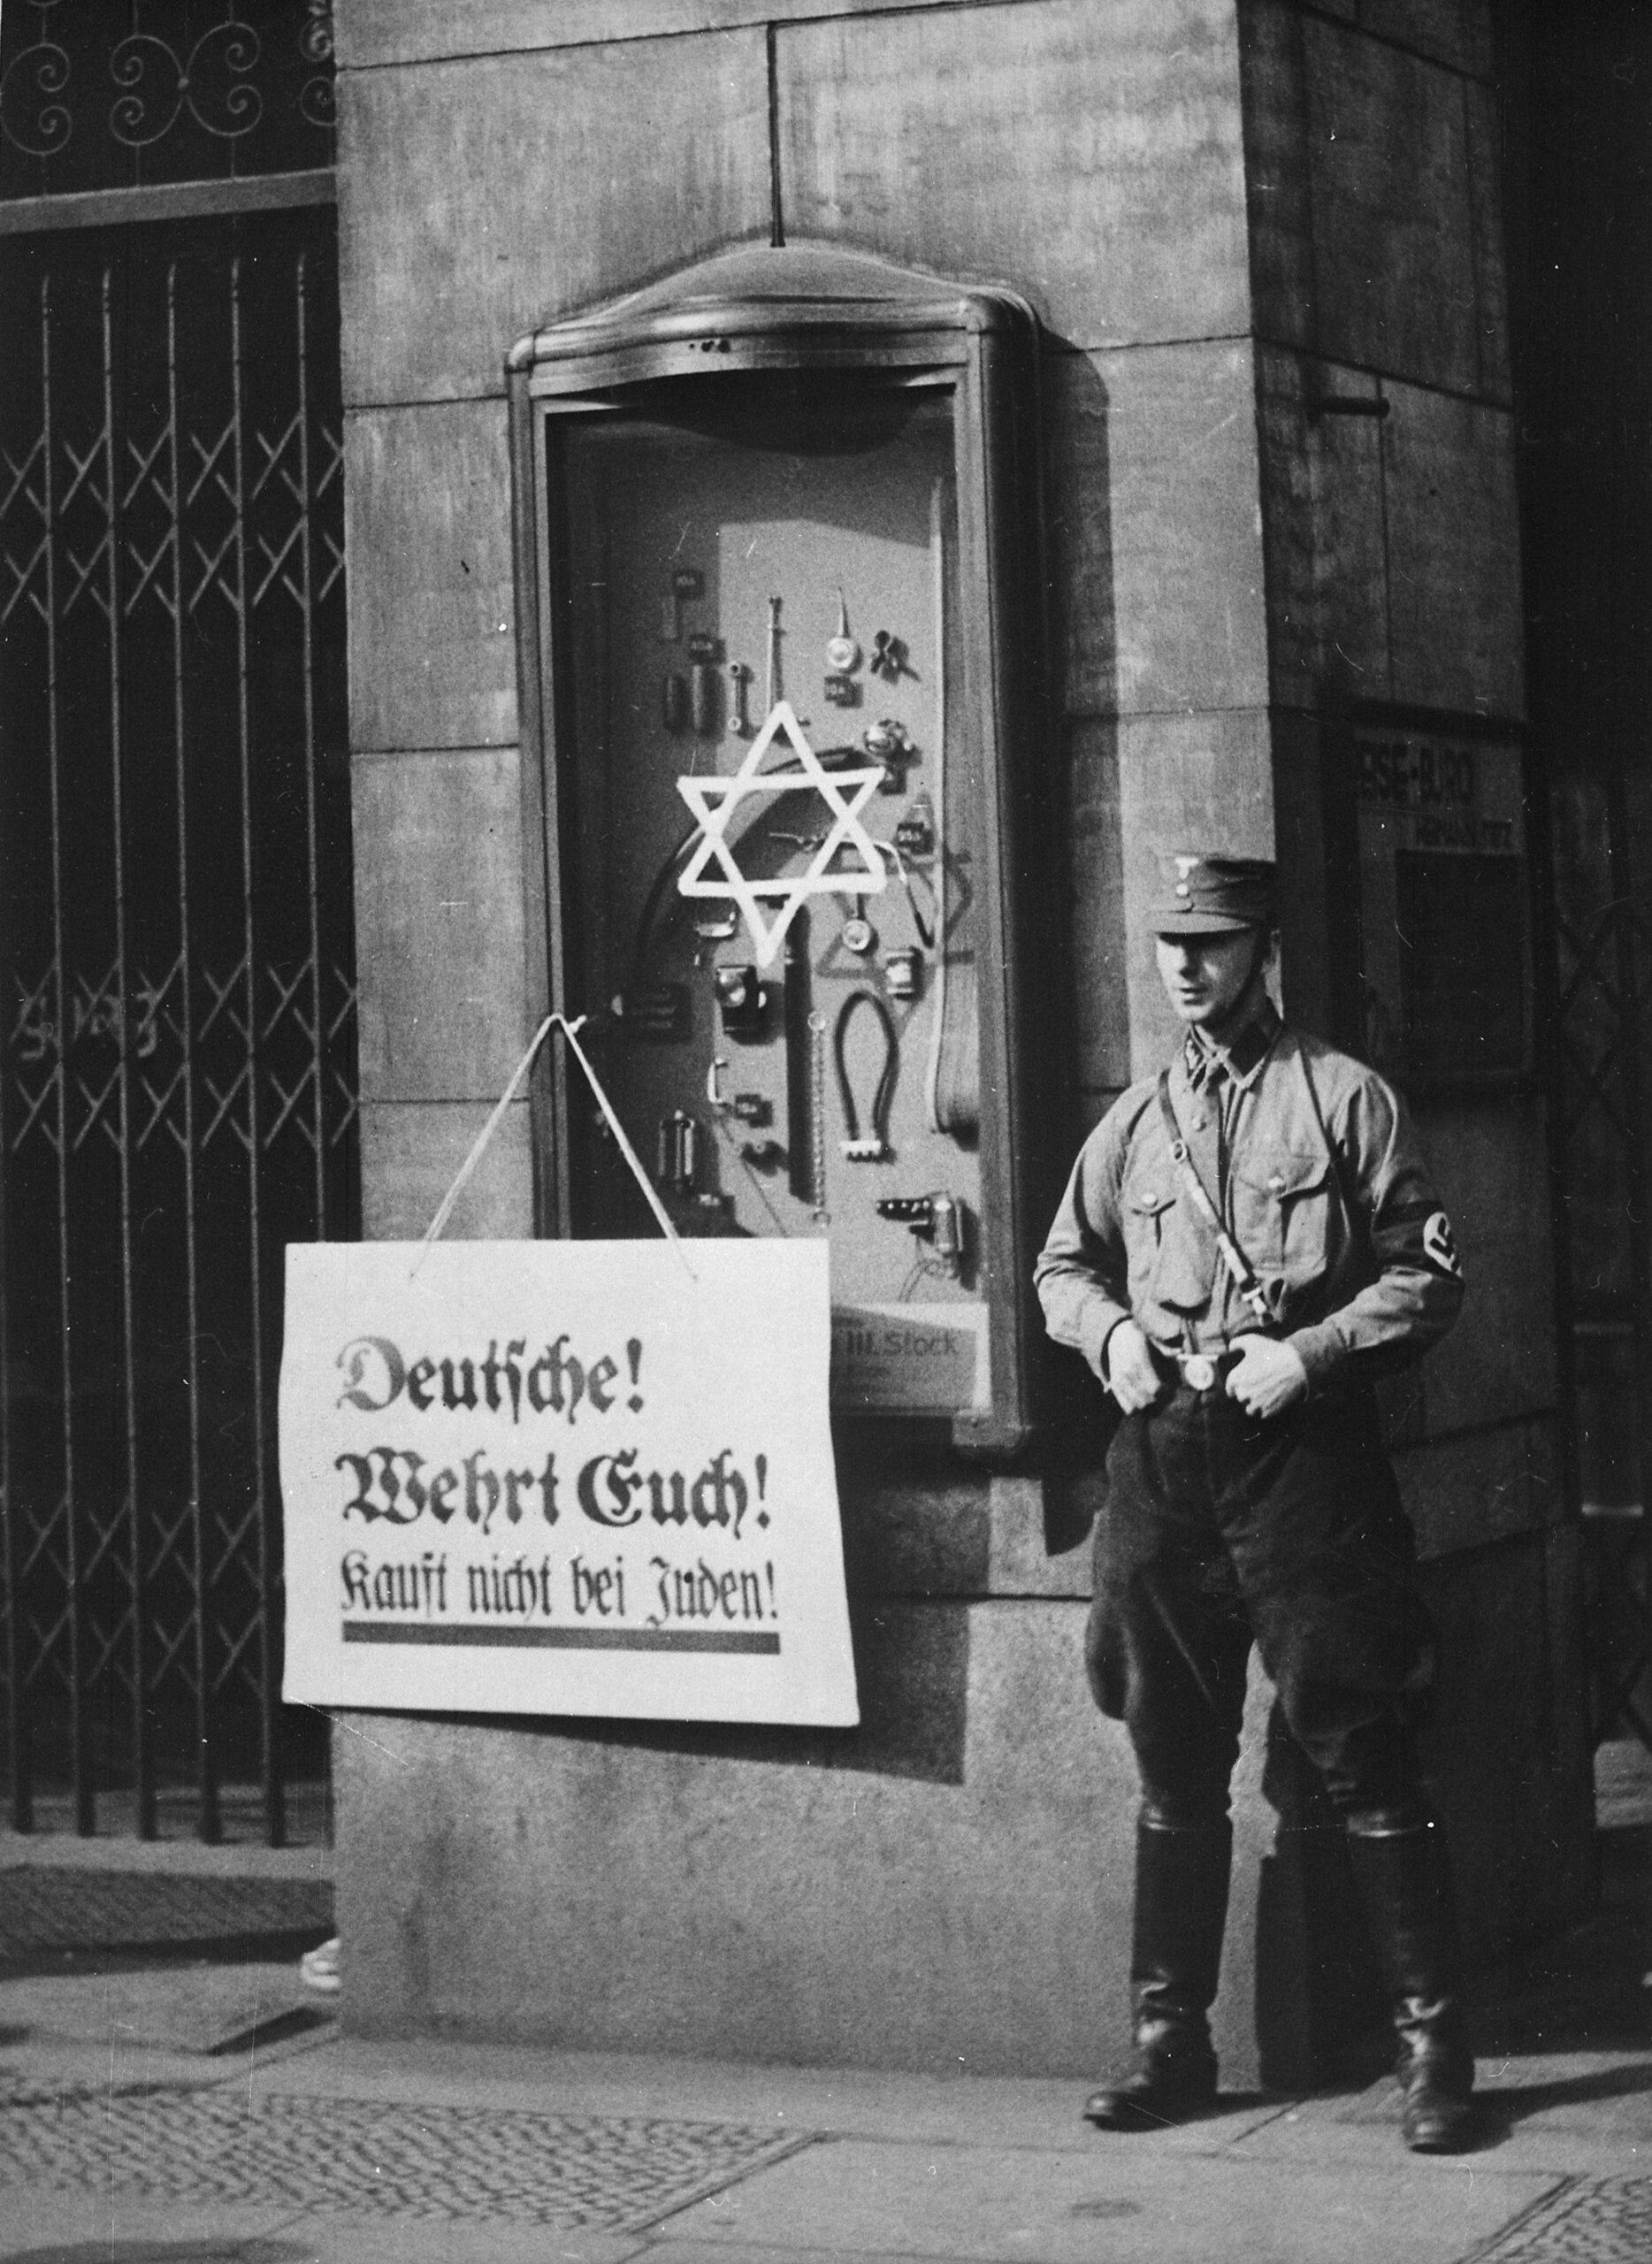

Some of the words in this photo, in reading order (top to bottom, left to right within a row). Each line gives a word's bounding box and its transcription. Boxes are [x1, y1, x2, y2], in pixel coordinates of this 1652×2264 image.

[335, 1334, 645, 1426] Deutsche!
[883, 1329, 960, 1357] Stock
[334, 1446, 560, 1535] Wehrt
[577, 1447, 770, 1540] Euch!
[340, 1549, 446, 1618] Kauft
[467, 1555, 551, 1621] nicht
[570, 1554, 624, 1618] bei
[646, 1555, 778, 1627] Juden!
